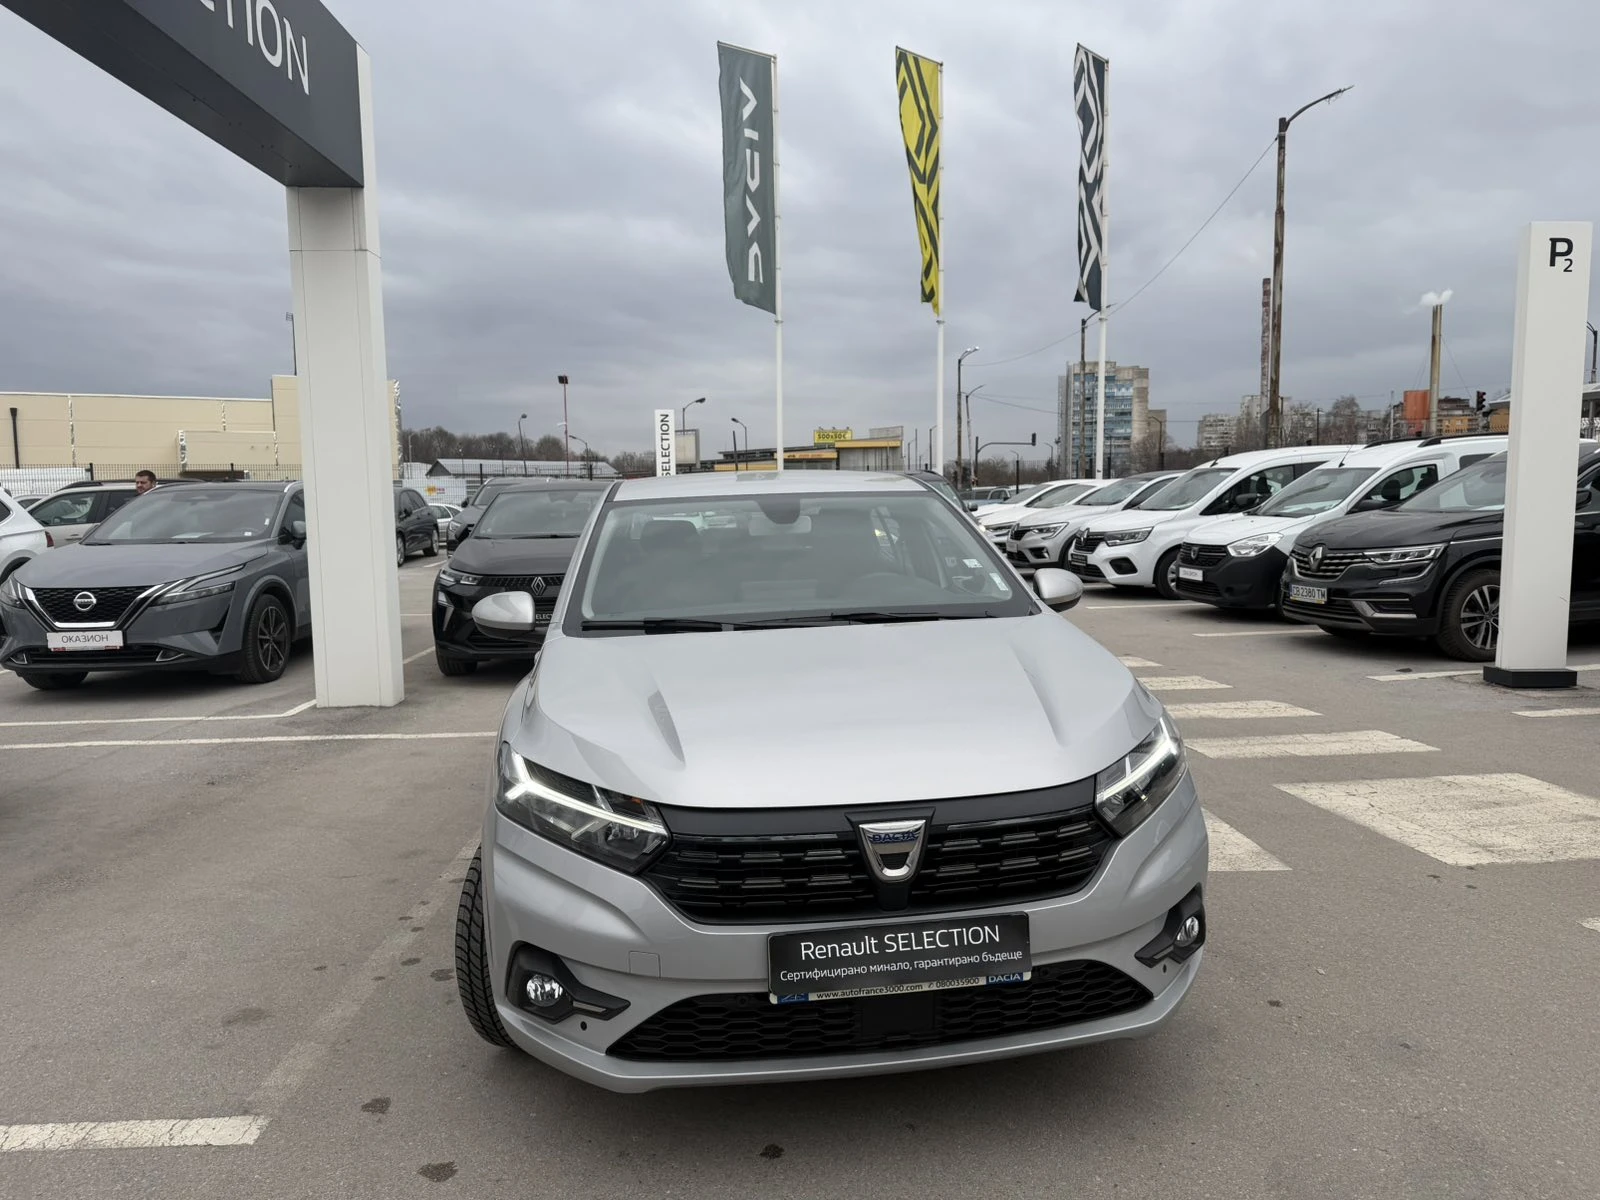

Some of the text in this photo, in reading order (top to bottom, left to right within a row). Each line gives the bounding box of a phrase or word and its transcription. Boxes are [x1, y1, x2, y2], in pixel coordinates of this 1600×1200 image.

[200, 0, 310, 95] ION
[61, 635, 108, 643] ОКАЗИОН
[872, 831, 917, 842] DACIA
[800, 924, 1000, 960] Renault SELECTION
[780, 950, 1023, 982] Сертифицирано минало, гарантирано бъдеще
[988, 973, 1021, 983] DACIA
[816, 983, 923, 999] www.autofrance3000.com
